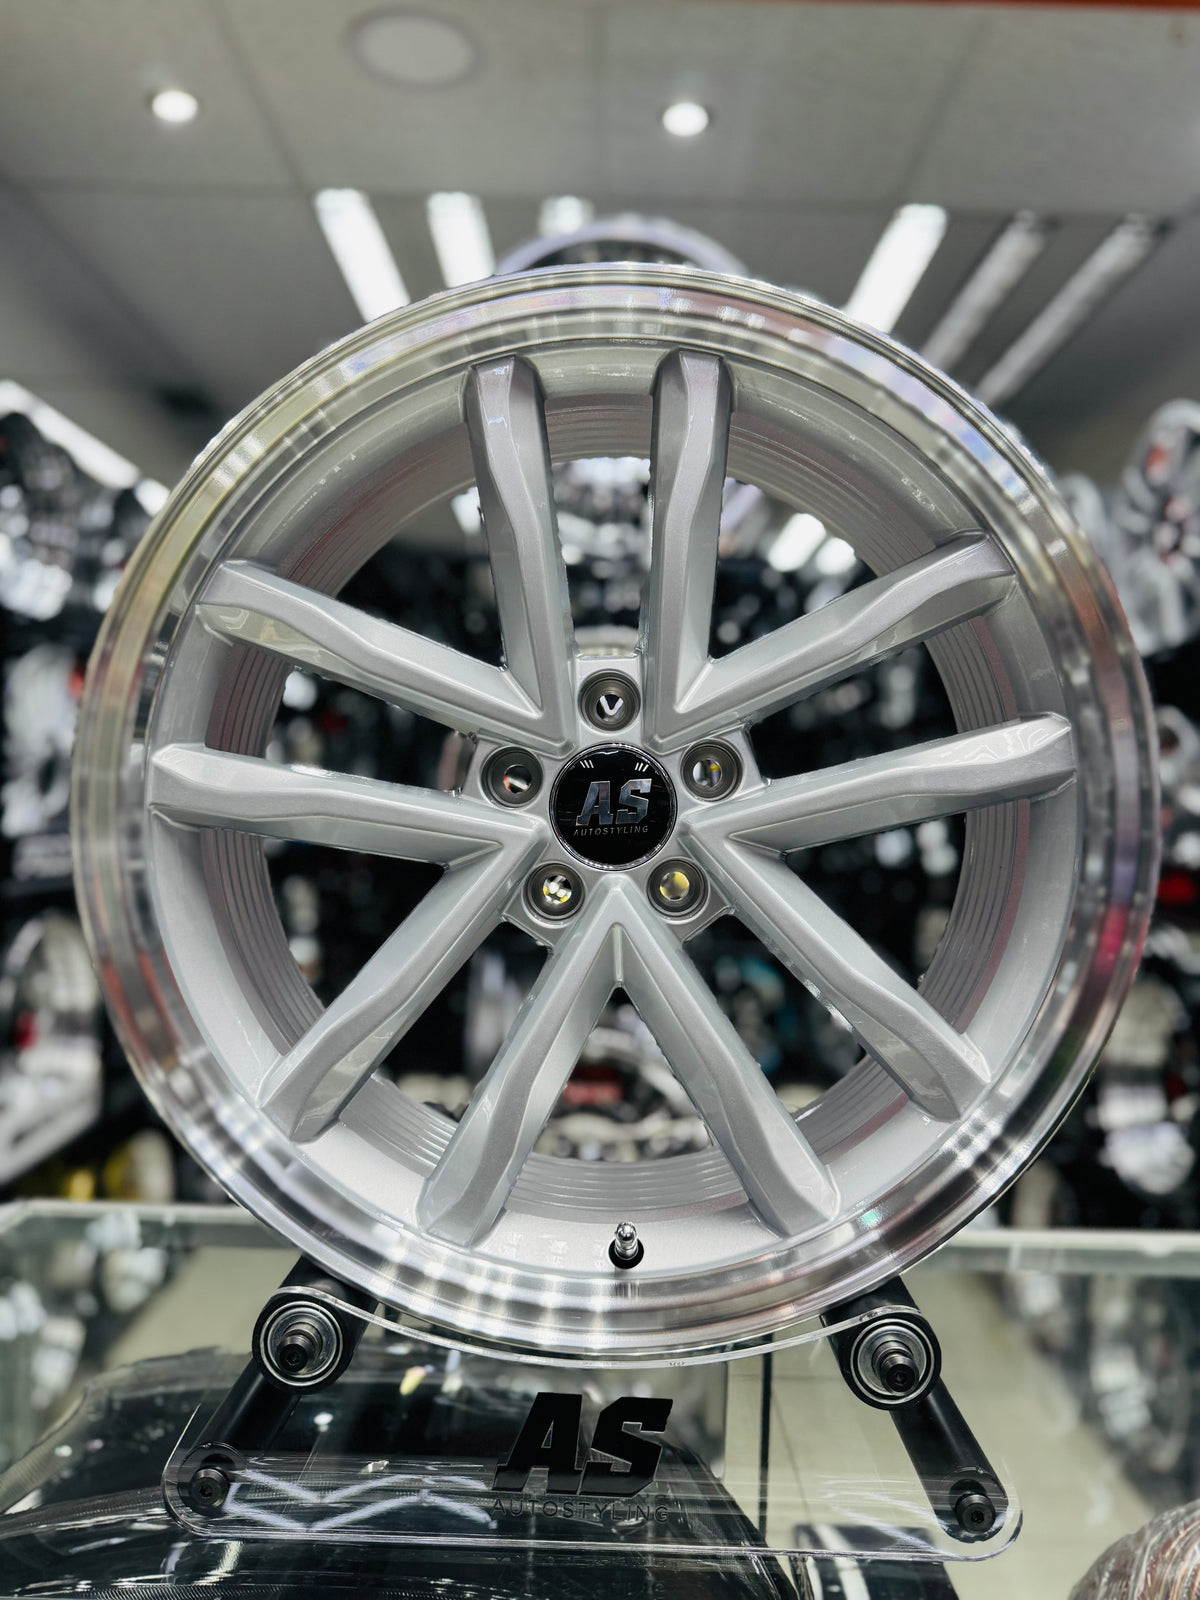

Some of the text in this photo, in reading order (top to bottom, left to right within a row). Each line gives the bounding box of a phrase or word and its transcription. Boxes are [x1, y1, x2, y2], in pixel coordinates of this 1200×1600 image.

[575, 778, 652, 826] AS
[573, 825, 649, 837] AUTOSTYLING
[492, 1392, 673, 1499] AS
[491, 1500, 670, 1523] AUTOSTYLING
